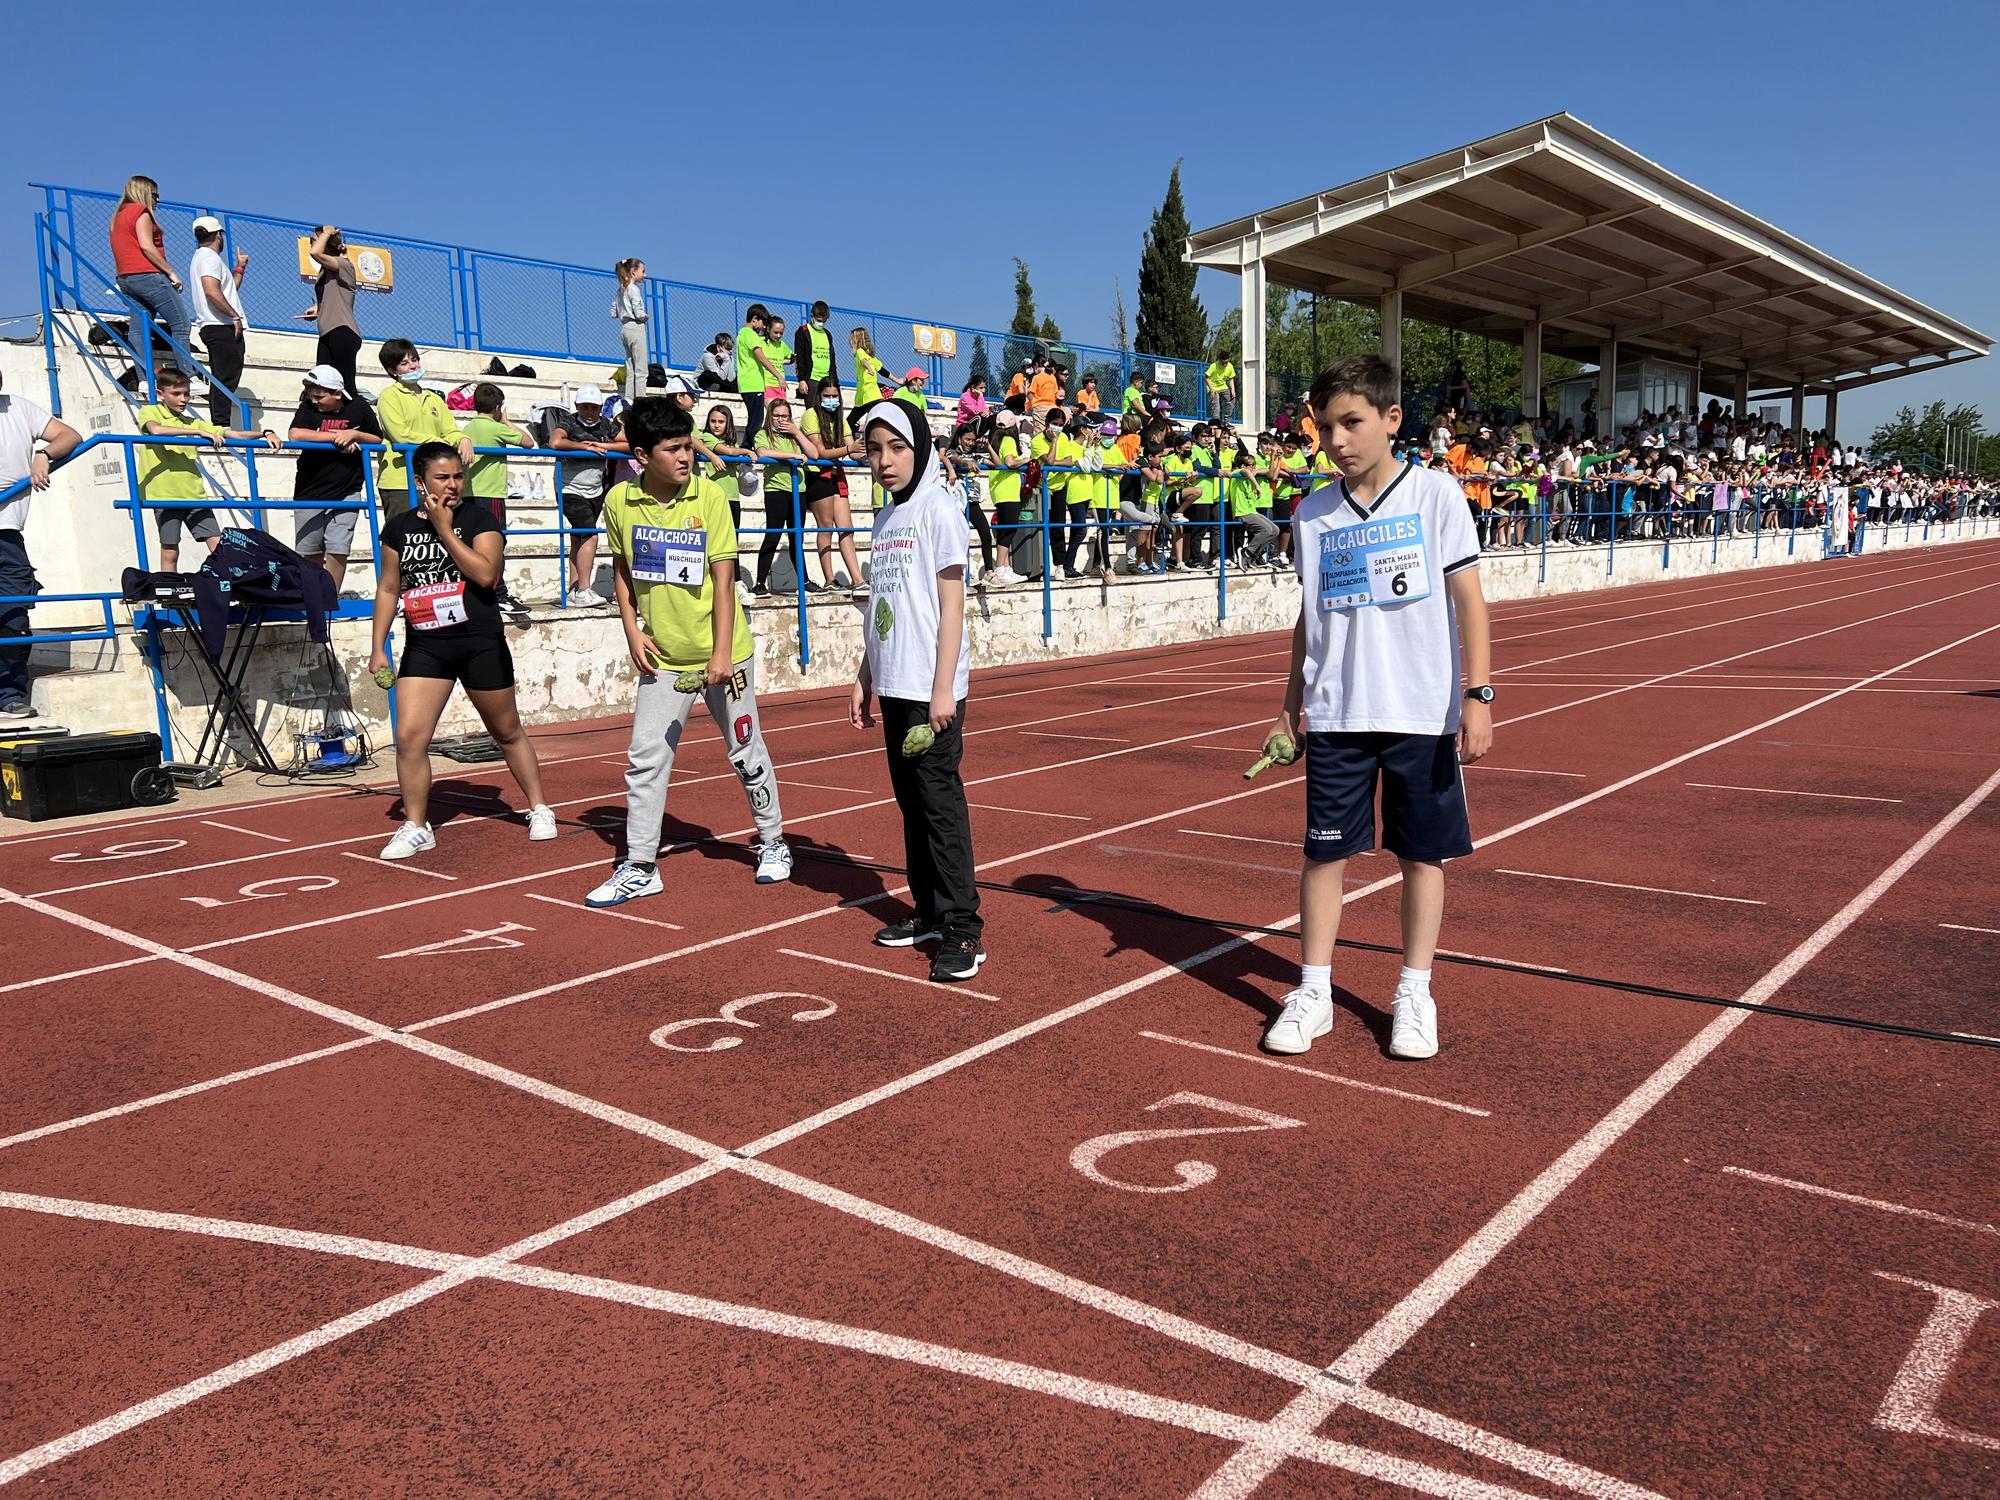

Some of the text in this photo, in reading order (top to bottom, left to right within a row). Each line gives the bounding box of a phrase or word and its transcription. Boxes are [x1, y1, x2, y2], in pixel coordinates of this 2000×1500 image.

[404, 533, 432, 545] YOU
[635, 527, 702, 546] ALCACHOFA
[1323, 520, 1417, 554] ALCAUCILES
[400, 542, 449, 563] DOIN
[668, 555, 702, 564] HURCHILLO
[1374, 556, 1396, 567] SANTA
[678, 566, 690, 583] 4
[1374, 567, 1383, 575] DE
[1394, 561, 1421, 572] HUERTA
[1321, 566, 1367, 591] II OLIMPIADAS DE
[1329, 576, 1368, 589] LA ALCACHOFA
[1391, 571, 1408, 597] 6
[408, 582, 460, 600] ARCASILES
[447, 609, 457, 623] 4
[376, 920, 537, 961] 4
[648, 991, 838, 1054] 3
[1069, 1090, 1309, 1195] 2
